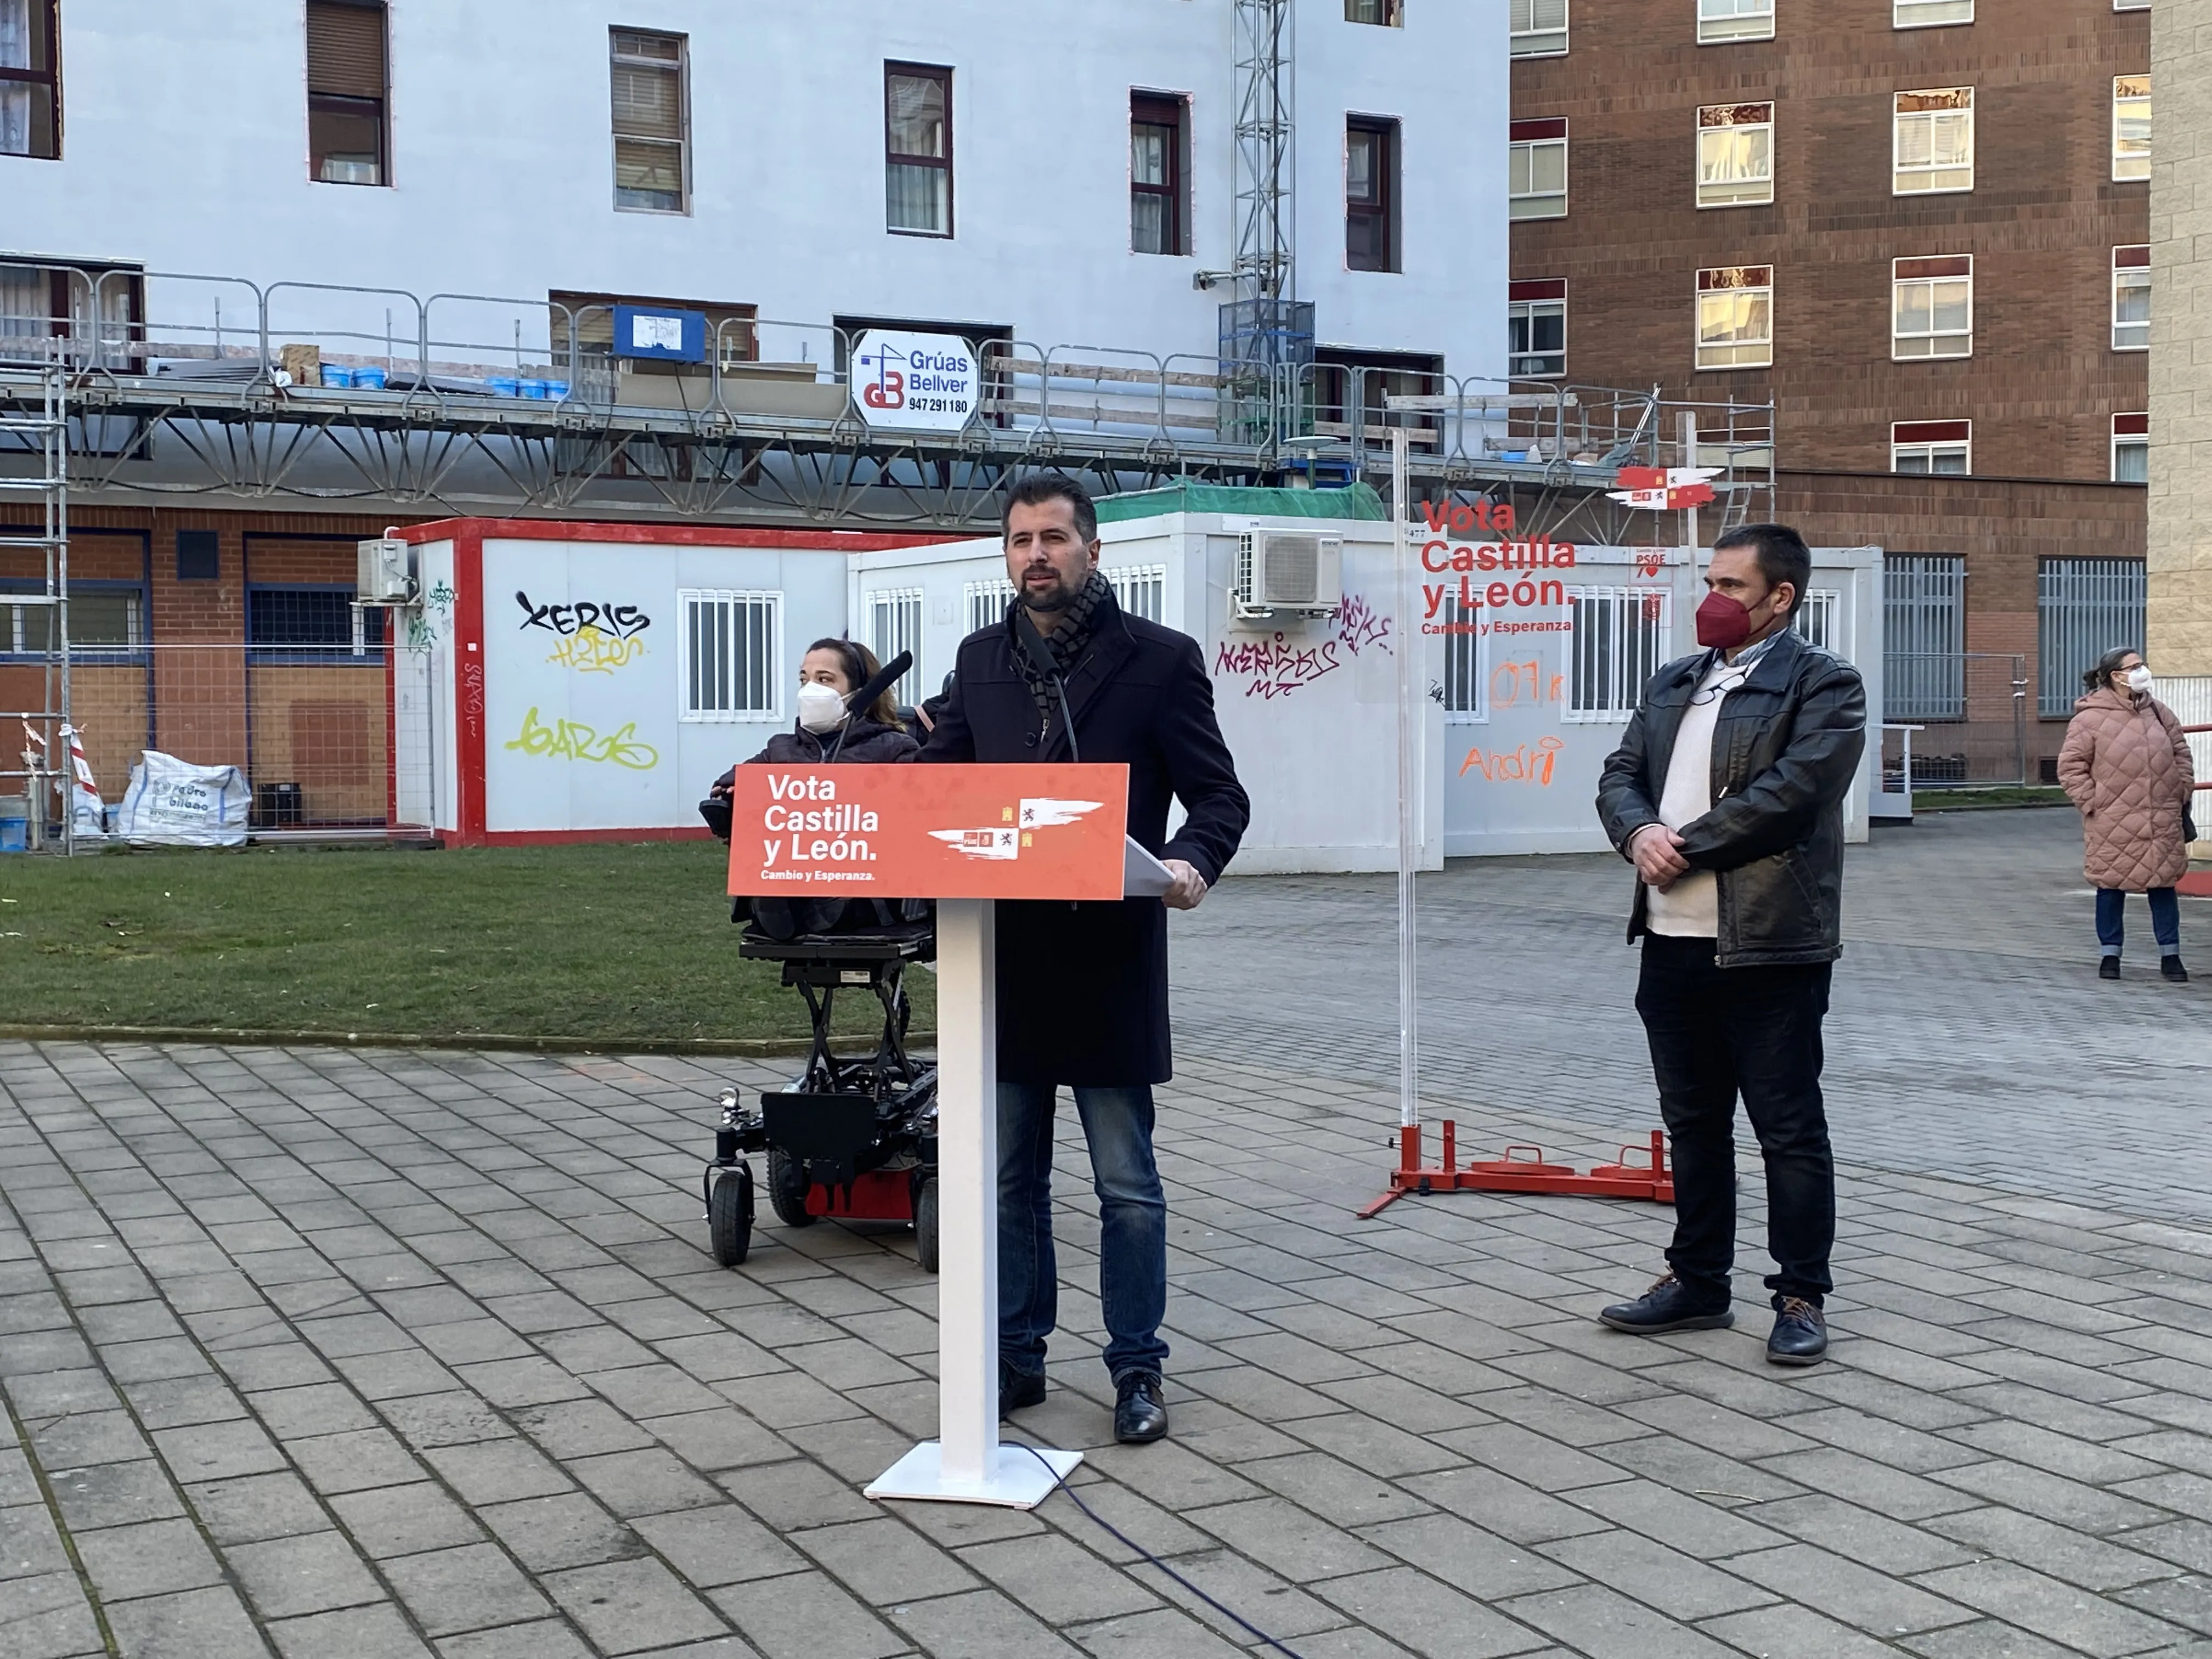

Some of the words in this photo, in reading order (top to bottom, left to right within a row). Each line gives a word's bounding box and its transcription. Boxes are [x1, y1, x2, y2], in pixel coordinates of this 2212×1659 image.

[910, 351, 968, 373] Grúas
[910, 373, 968, 393] Bellver
[1422, 498, 1515, 533] Vota
[1421, 532, 1576, 573] Castilla
[1637, 554, 1666, 565] PSOE
[1423, 584, 1445, 619] y
[1460, 571, 1576, 608] León.
[1481, 624, 1489, 636] y
[767, 774, 836, 800] Vota
[764, 804, 878, 832] Castilla
[763, 839, 781, 867] y
[791, 832, 877, 860] León.
[760, 870, 803, 880] Cambio
[805, 871, 812, 882] y
[814, 870, 876, 883] Esperanza.
